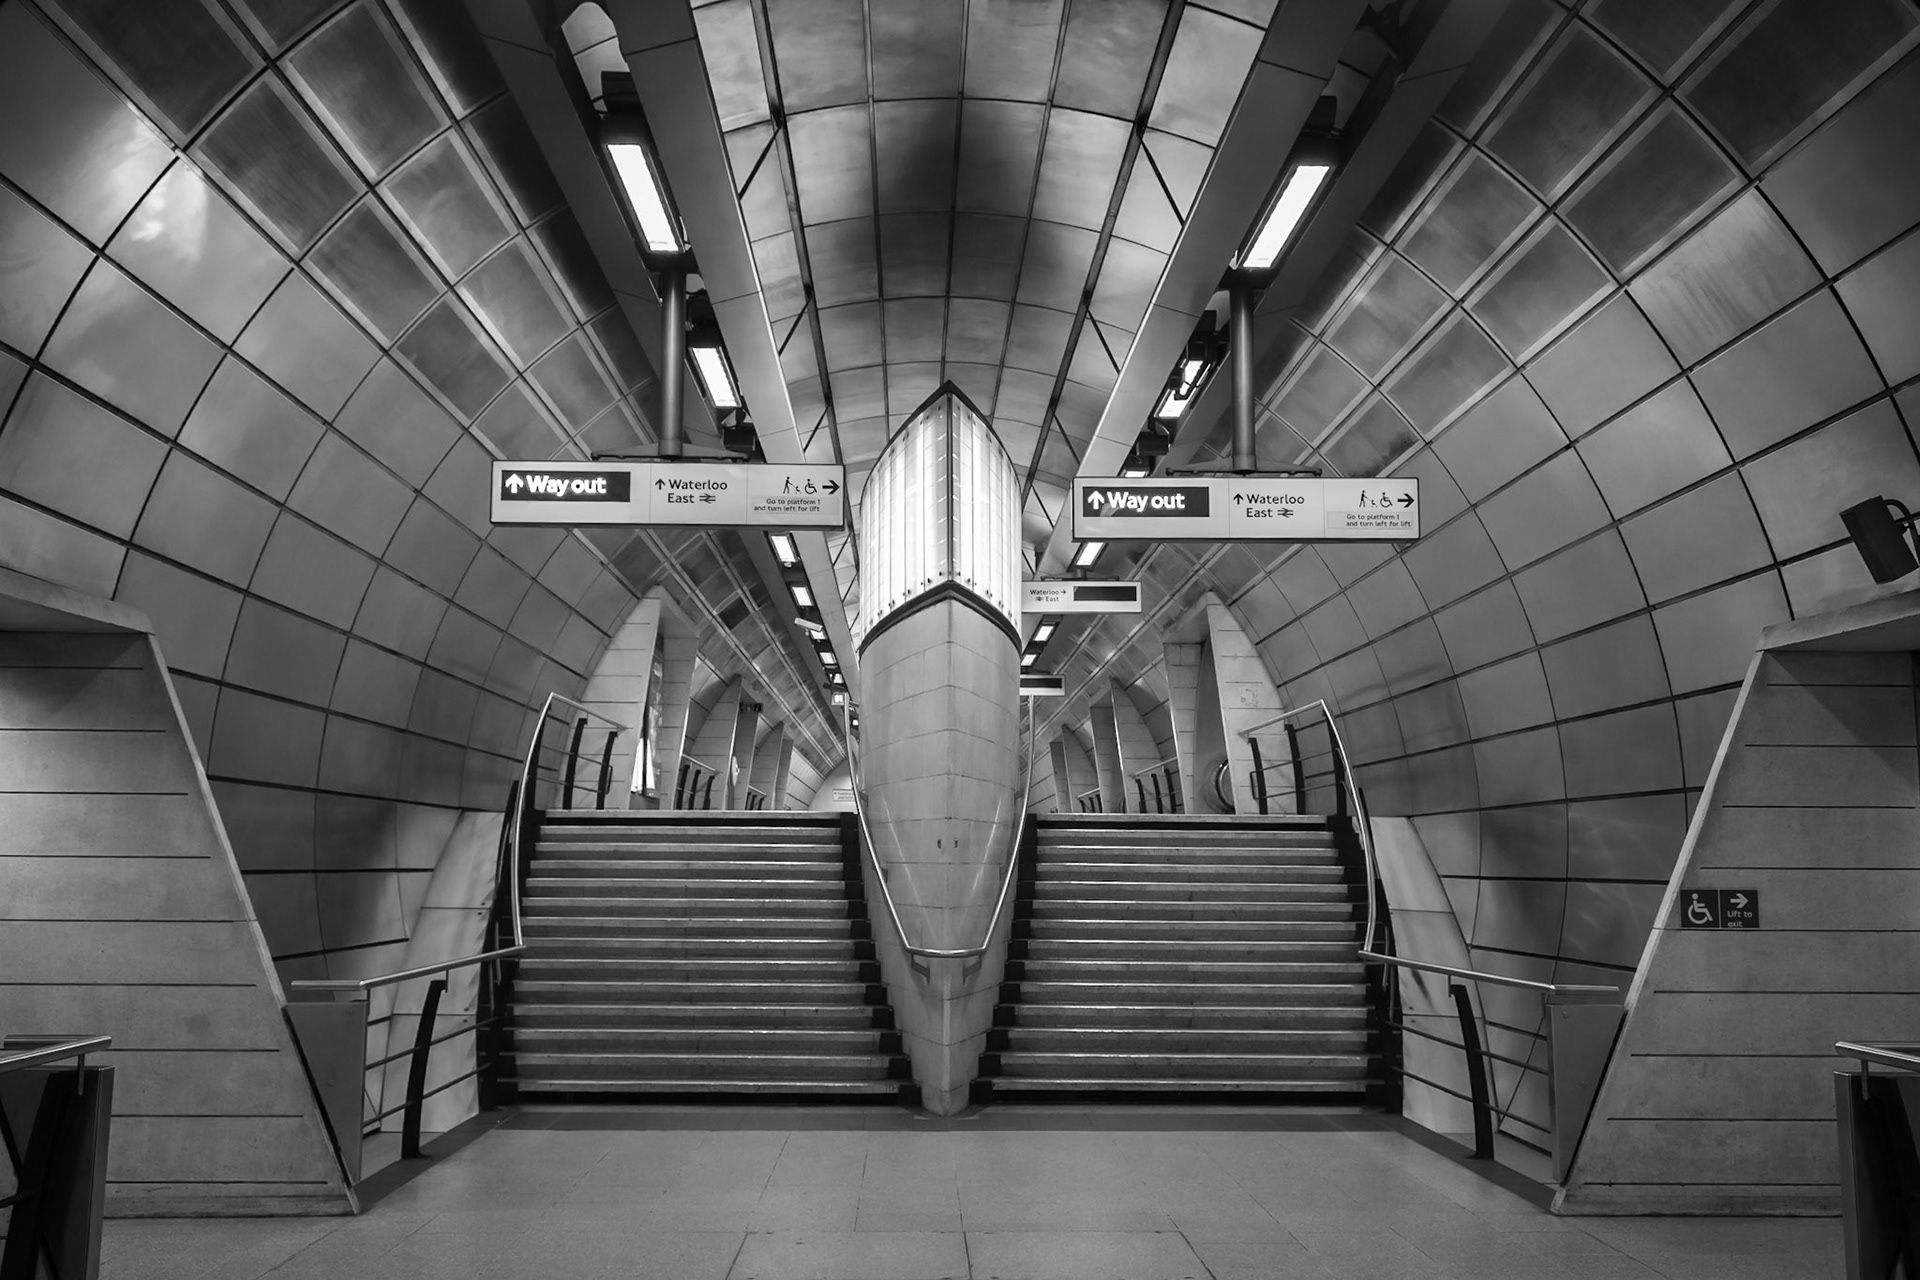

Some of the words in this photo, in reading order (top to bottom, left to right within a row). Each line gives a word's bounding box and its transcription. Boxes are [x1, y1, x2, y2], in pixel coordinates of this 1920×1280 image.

[526, 474, 570, 497] Way
[571, 477, 607, 494] out
[668, 479, 728, 490] Waterloo
[667, 492, 695, 504] East
[787, 498, 816, 506] platform
[1106, 491, 1149, 513] Way
[1150, 493, 1186, 509] out
[1246, 493, 1305, 505] Waterloo
[1246, 507, 1273, 518] East
[1727, 910, 1742, 918] Lift
[1743, 910, 1753, 918] to
